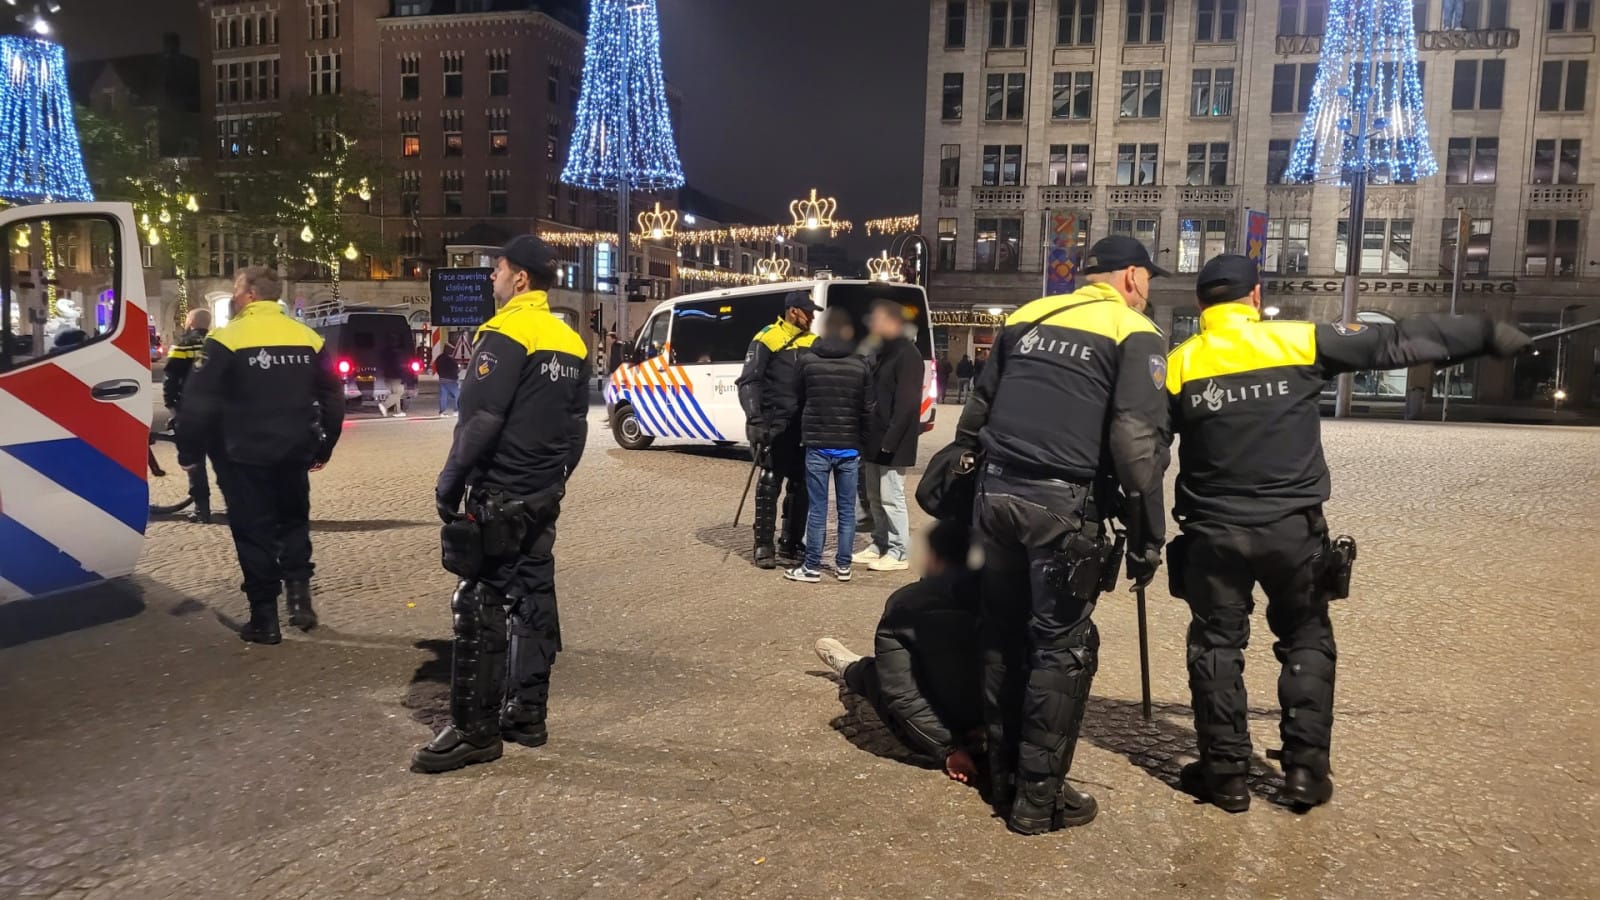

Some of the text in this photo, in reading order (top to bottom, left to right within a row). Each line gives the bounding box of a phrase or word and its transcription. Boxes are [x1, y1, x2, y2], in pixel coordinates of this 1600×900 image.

[1417, 29, 1520, 52] USSAUD
[438, 272, 487, 281] Face covering
[402, 295, 430, 305] GASS
[932, 313, 968, 323] ADAME
[248, 348, 311, 369] POLITIE
[714, 380, 738, 395] POLITI
[1191, 378, 1289, 411] POLITIE
